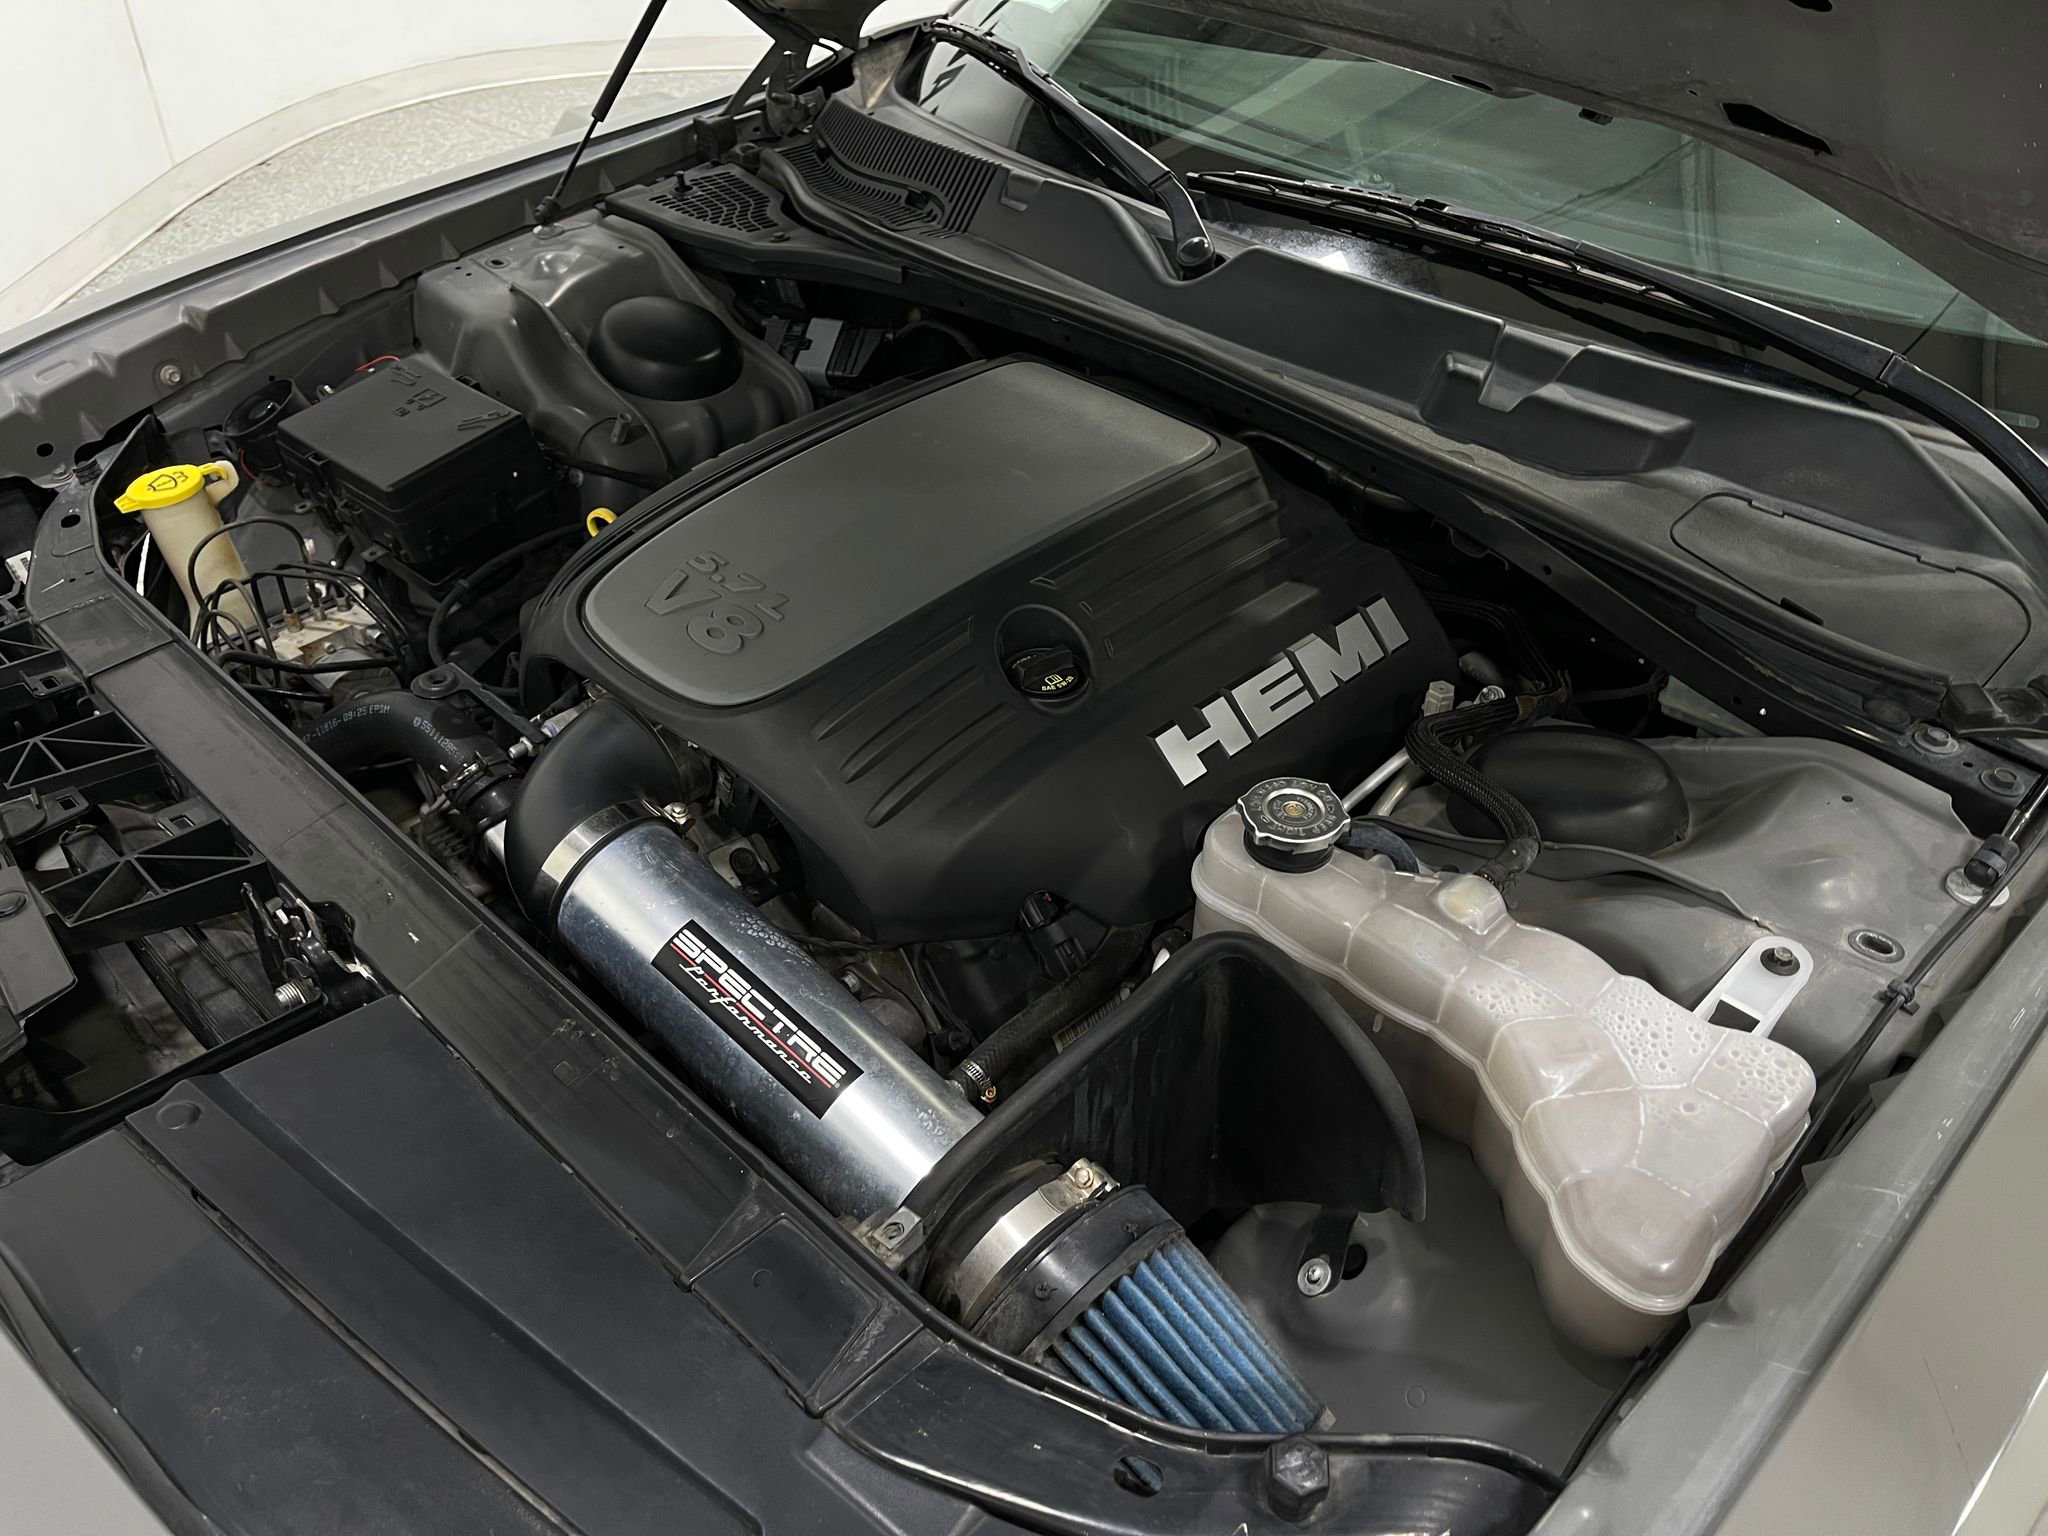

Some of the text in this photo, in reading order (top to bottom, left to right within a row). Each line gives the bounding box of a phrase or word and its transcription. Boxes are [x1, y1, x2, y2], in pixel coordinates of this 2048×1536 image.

[643, 568, 765, 656] V8
[686, 551, 790, 621] 5.7L
[1153, 597, 1410, 788] HEMI
[672, 928, 847, 1086] SPECTRE
[678, 963, 812, 1085] Performance
